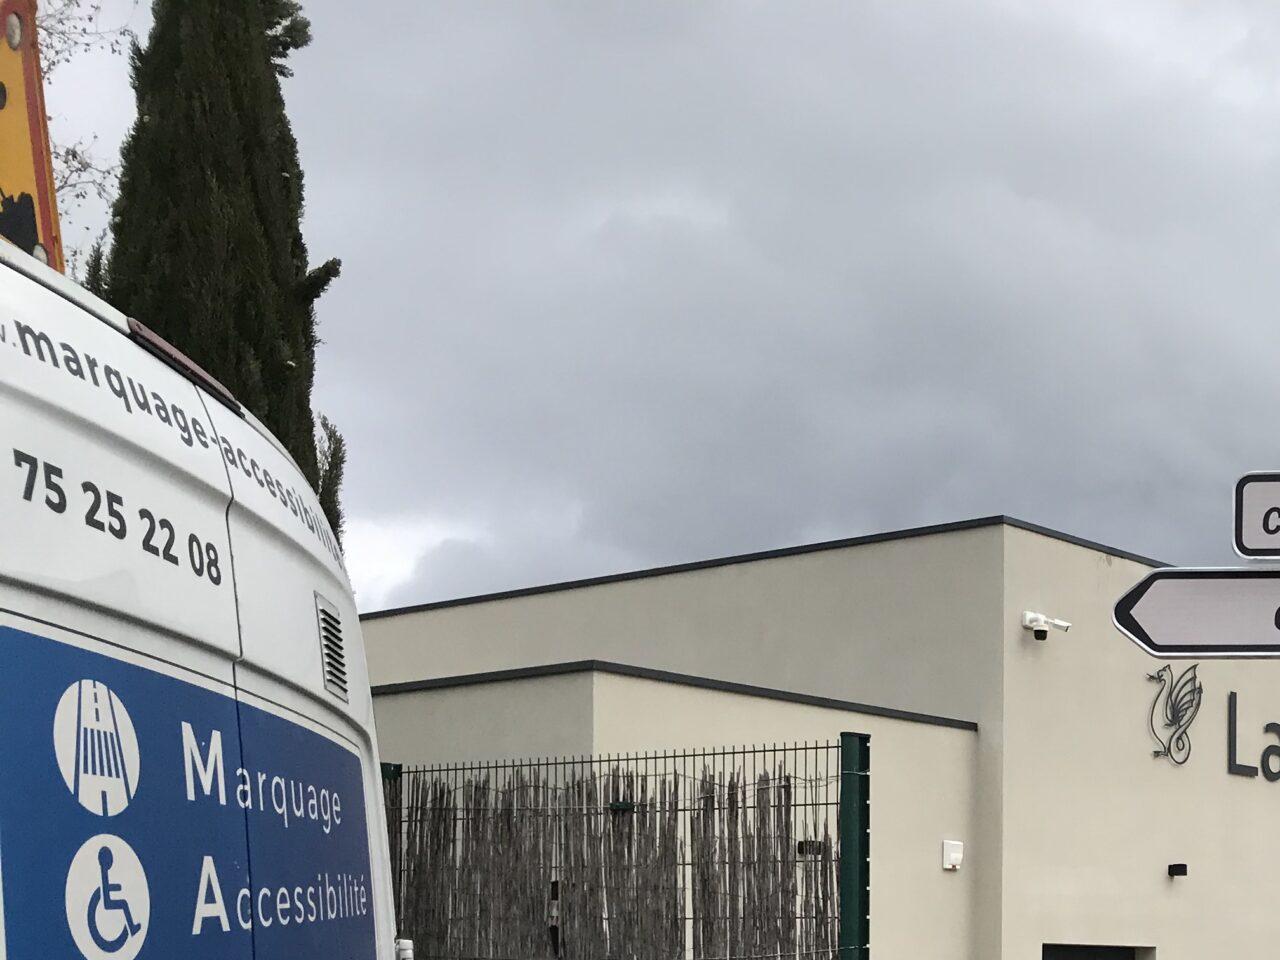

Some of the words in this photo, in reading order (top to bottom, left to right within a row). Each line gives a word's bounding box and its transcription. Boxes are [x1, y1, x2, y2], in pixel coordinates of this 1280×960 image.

[13, 448, 67, 514] 75
[81, 481, 127, 540] 25
[138, 508, 179, 566] 22
[188, 533, 222, 586] 08
[181, 721, 341, 834] Marquage
[192, 856, 368, 935] Accessibilité
